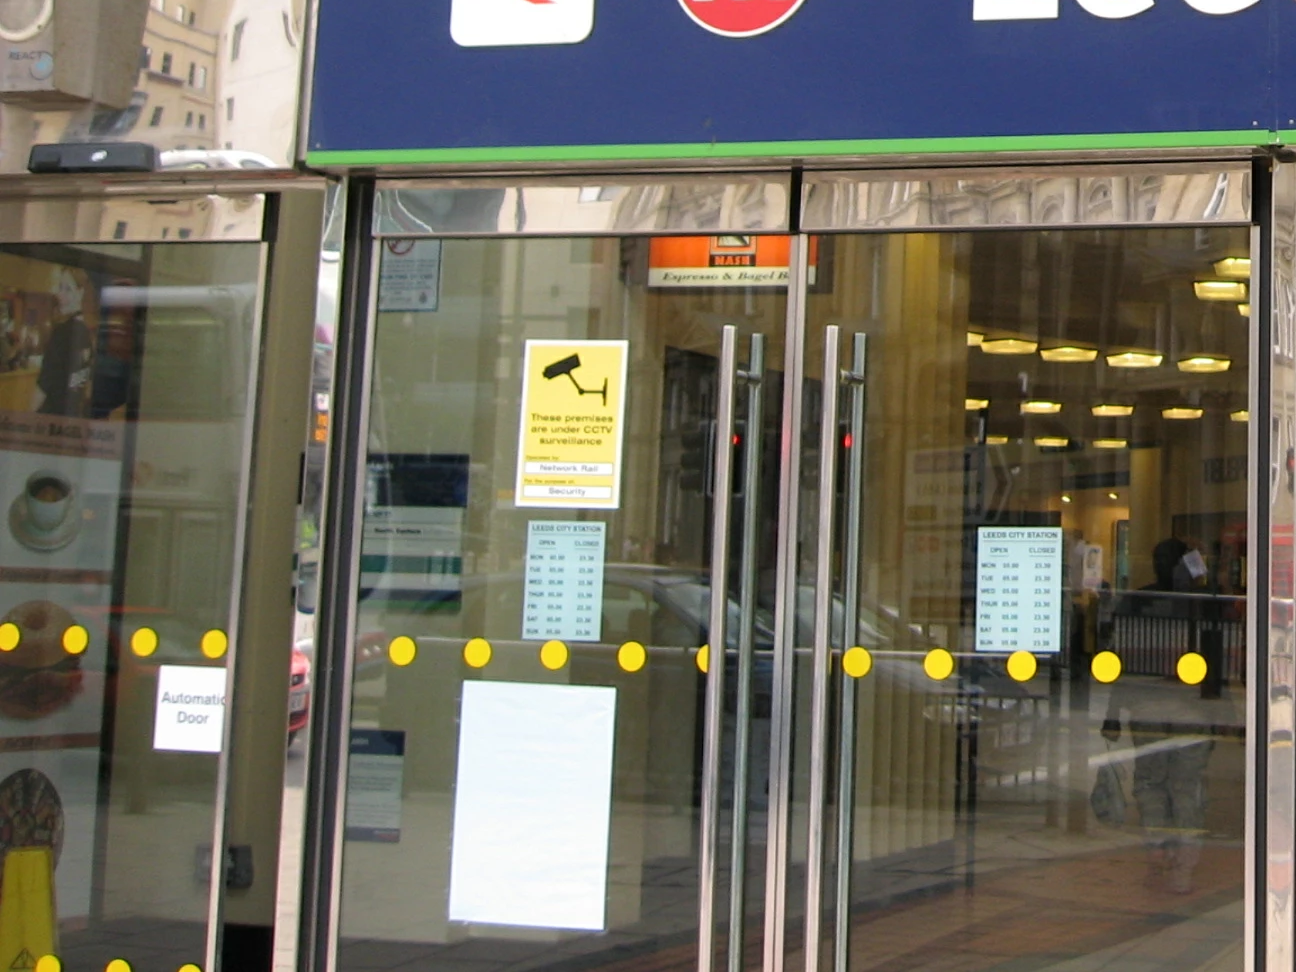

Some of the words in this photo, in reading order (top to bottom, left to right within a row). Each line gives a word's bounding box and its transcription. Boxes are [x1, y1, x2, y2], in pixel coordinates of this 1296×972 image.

[663, 272, 719, 282] Espresso
[738, 271, 774, 282] Bagel
[531, 413, 562, 422] These
[565, 414, 613, 426] premises
[551, 426, 580, 434] under
[583, 425, 613, 434] CCTV
[539, 437, 603, 446] surveillance
[539, 464, 577, 472] Network
[581, 464, 598, 472] Rail
[548, 487, 586, 496] Security
[982, 531, 1007, 539] LEEDS
[1008, 531, 1025, 539] CITY
[1027, 531, 1058, 539] STATION
[177, 711, 210, 724] Door
